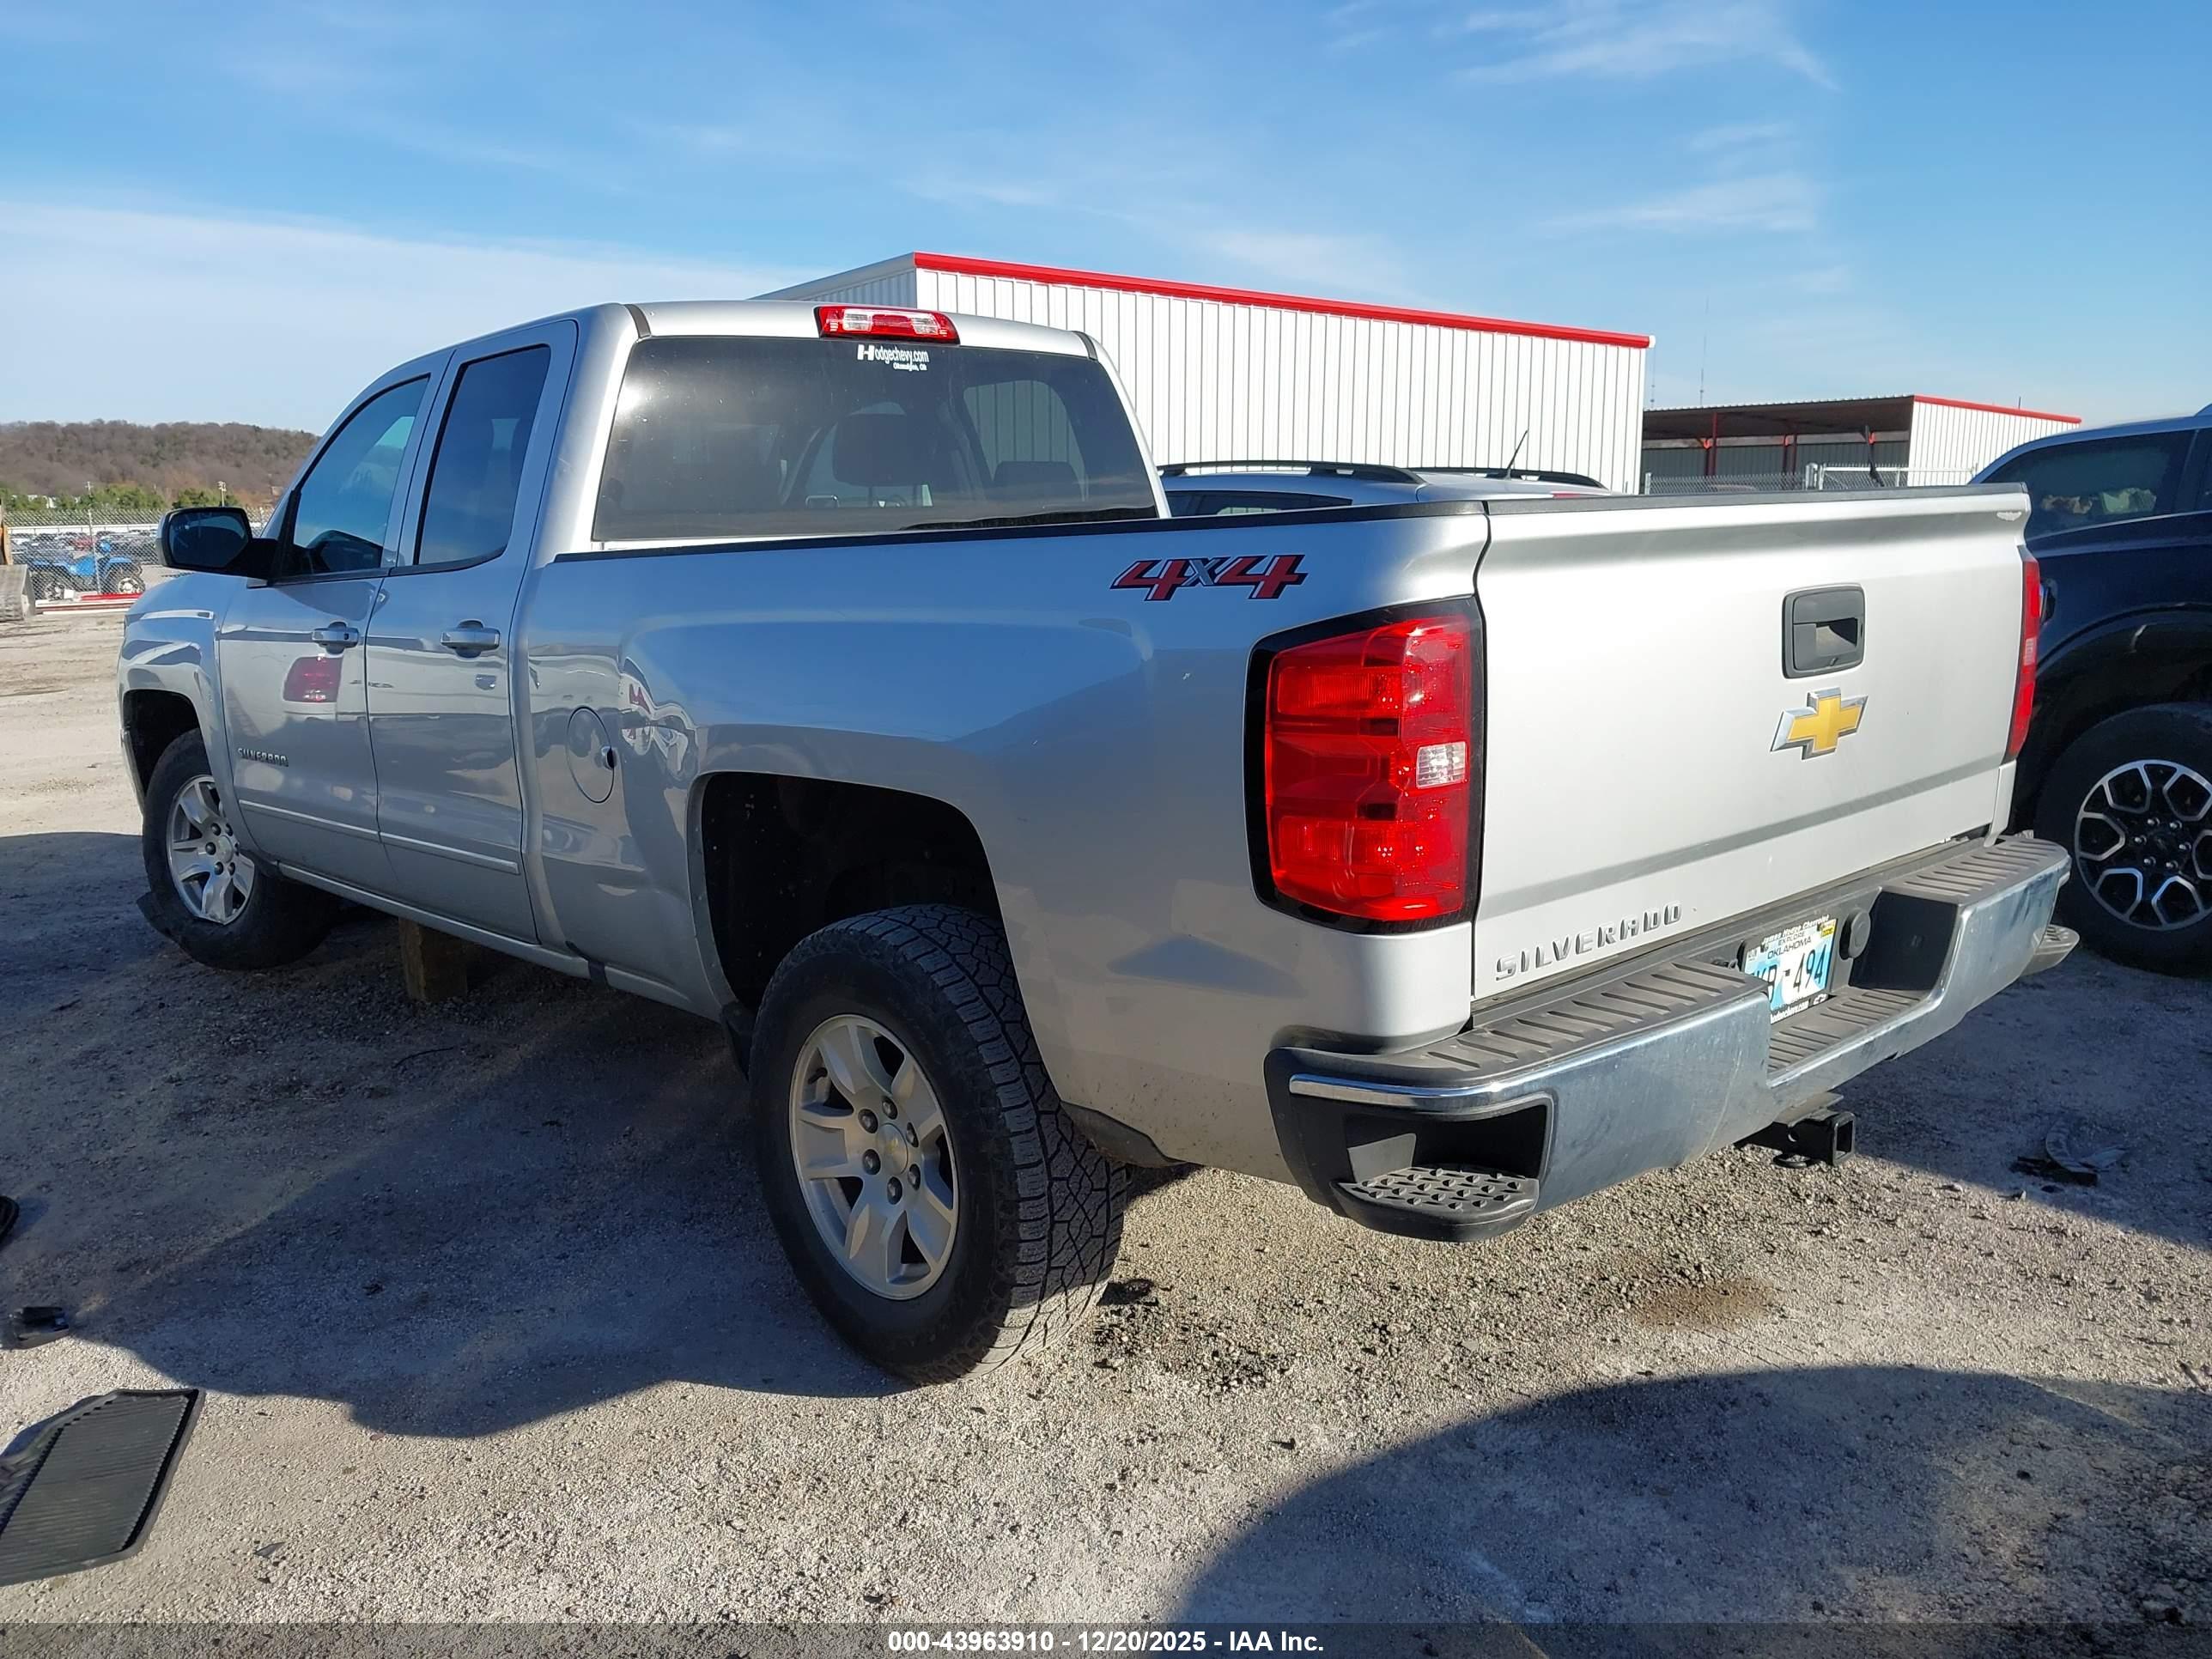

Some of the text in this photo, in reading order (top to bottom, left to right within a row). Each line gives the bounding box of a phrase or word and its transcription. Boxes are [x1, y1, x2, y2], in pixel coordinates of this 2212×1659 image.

[857, 343, 929, 364] Hodgechevy.com
[237, 748, 289, 766] SILVERADO
[1495, 902, 1683, 981] SILVERADO
[1766, 936, 1812, 960] OKLAHOMA
[1778, 931, 1806, 946] EXPLORE
